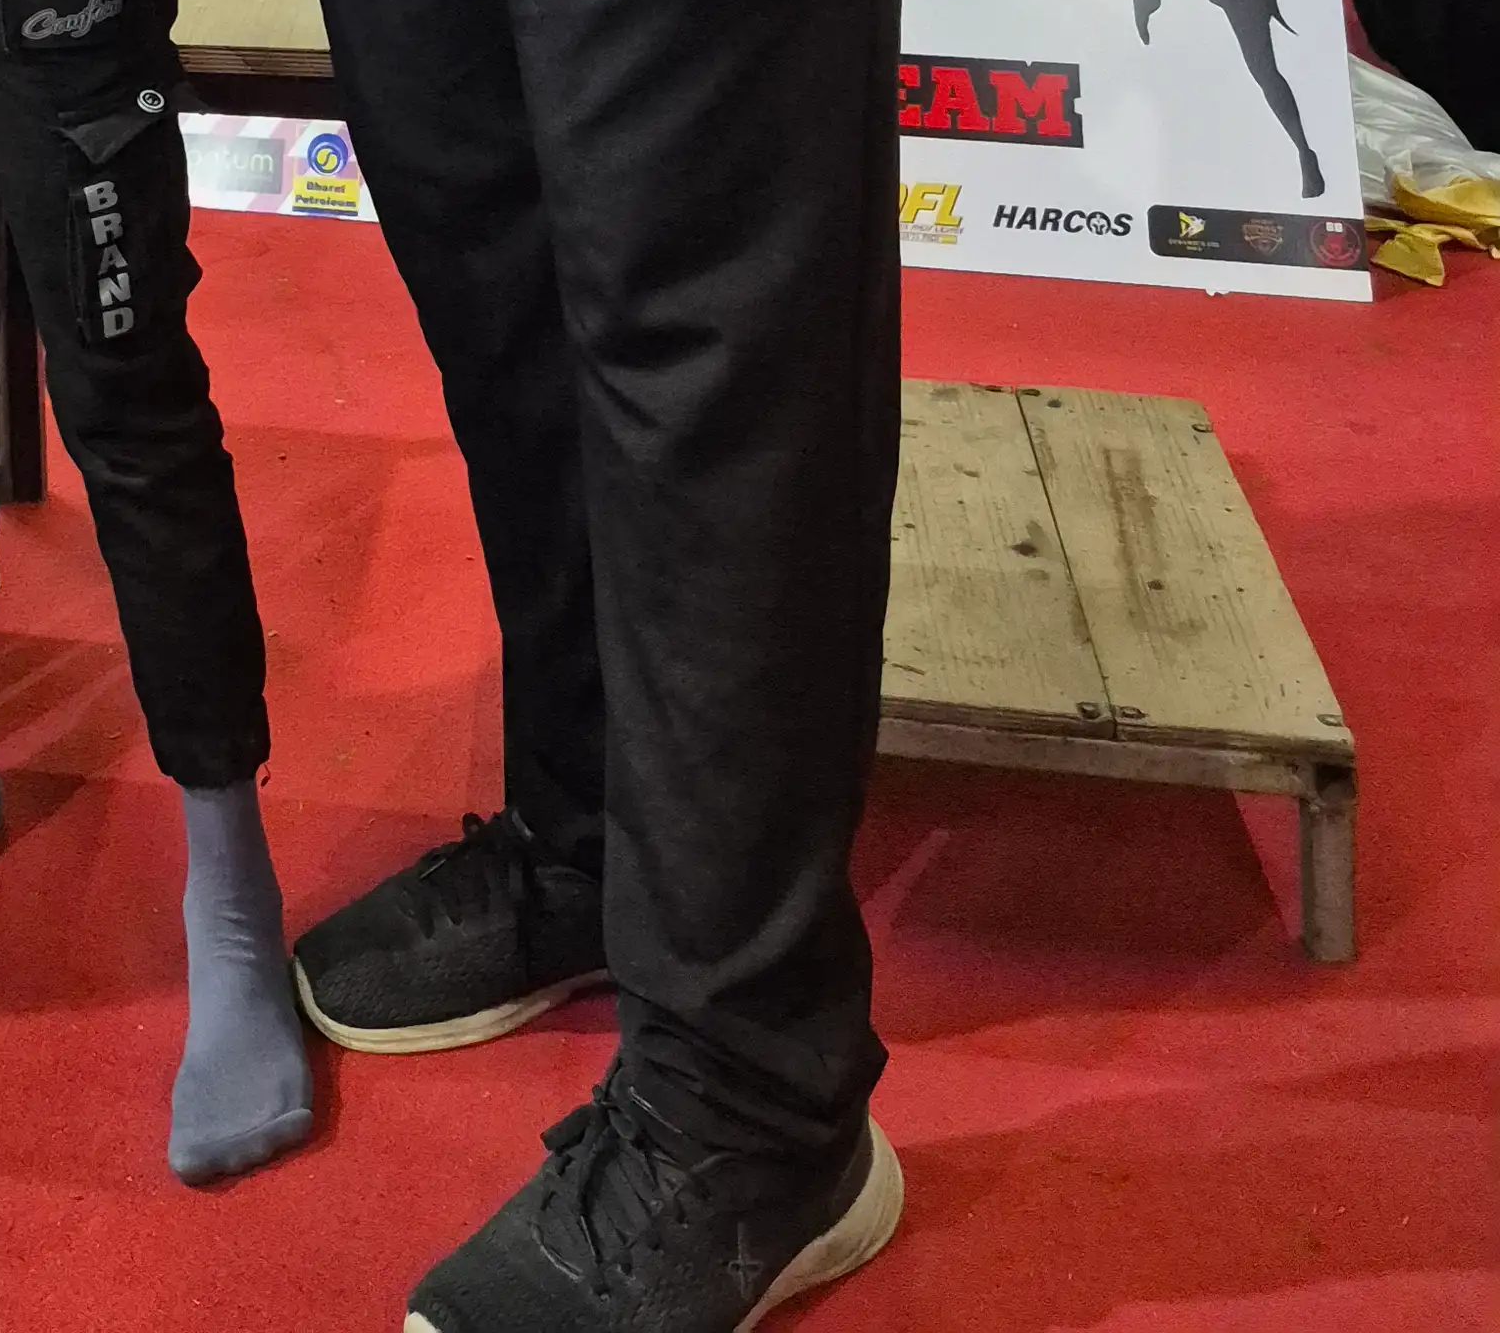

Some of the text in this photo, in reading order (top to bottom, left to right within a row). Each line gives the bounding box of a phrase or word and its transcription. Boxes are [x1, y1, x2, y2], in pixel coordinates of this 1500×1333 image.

[306, 180, 346, 194] Bharat
[294, 193, 357, 209] Petroleum
[992, 204, 1135, 237] HARCOS
[82, 180, 135, 339] BRAND
